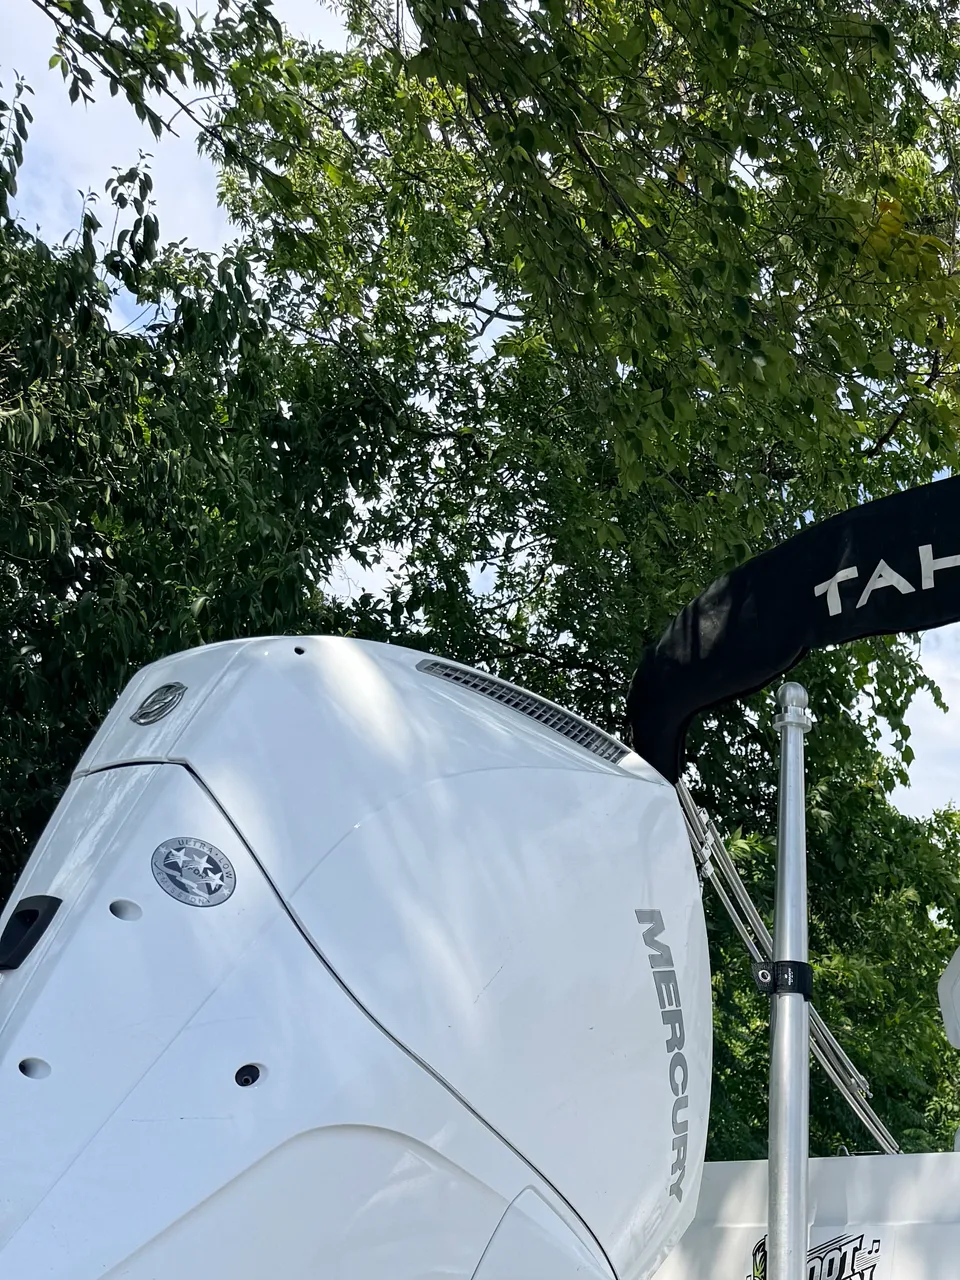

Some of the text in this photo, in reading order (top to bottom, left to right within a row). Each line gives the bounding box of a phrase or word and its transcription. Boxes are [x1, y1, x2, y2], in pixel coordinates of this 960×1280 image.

[177, 839, 214, 854] ULTRA
[218, 857, 233, 879] LOW
[635, 909, 688, 1203] MERCURY
